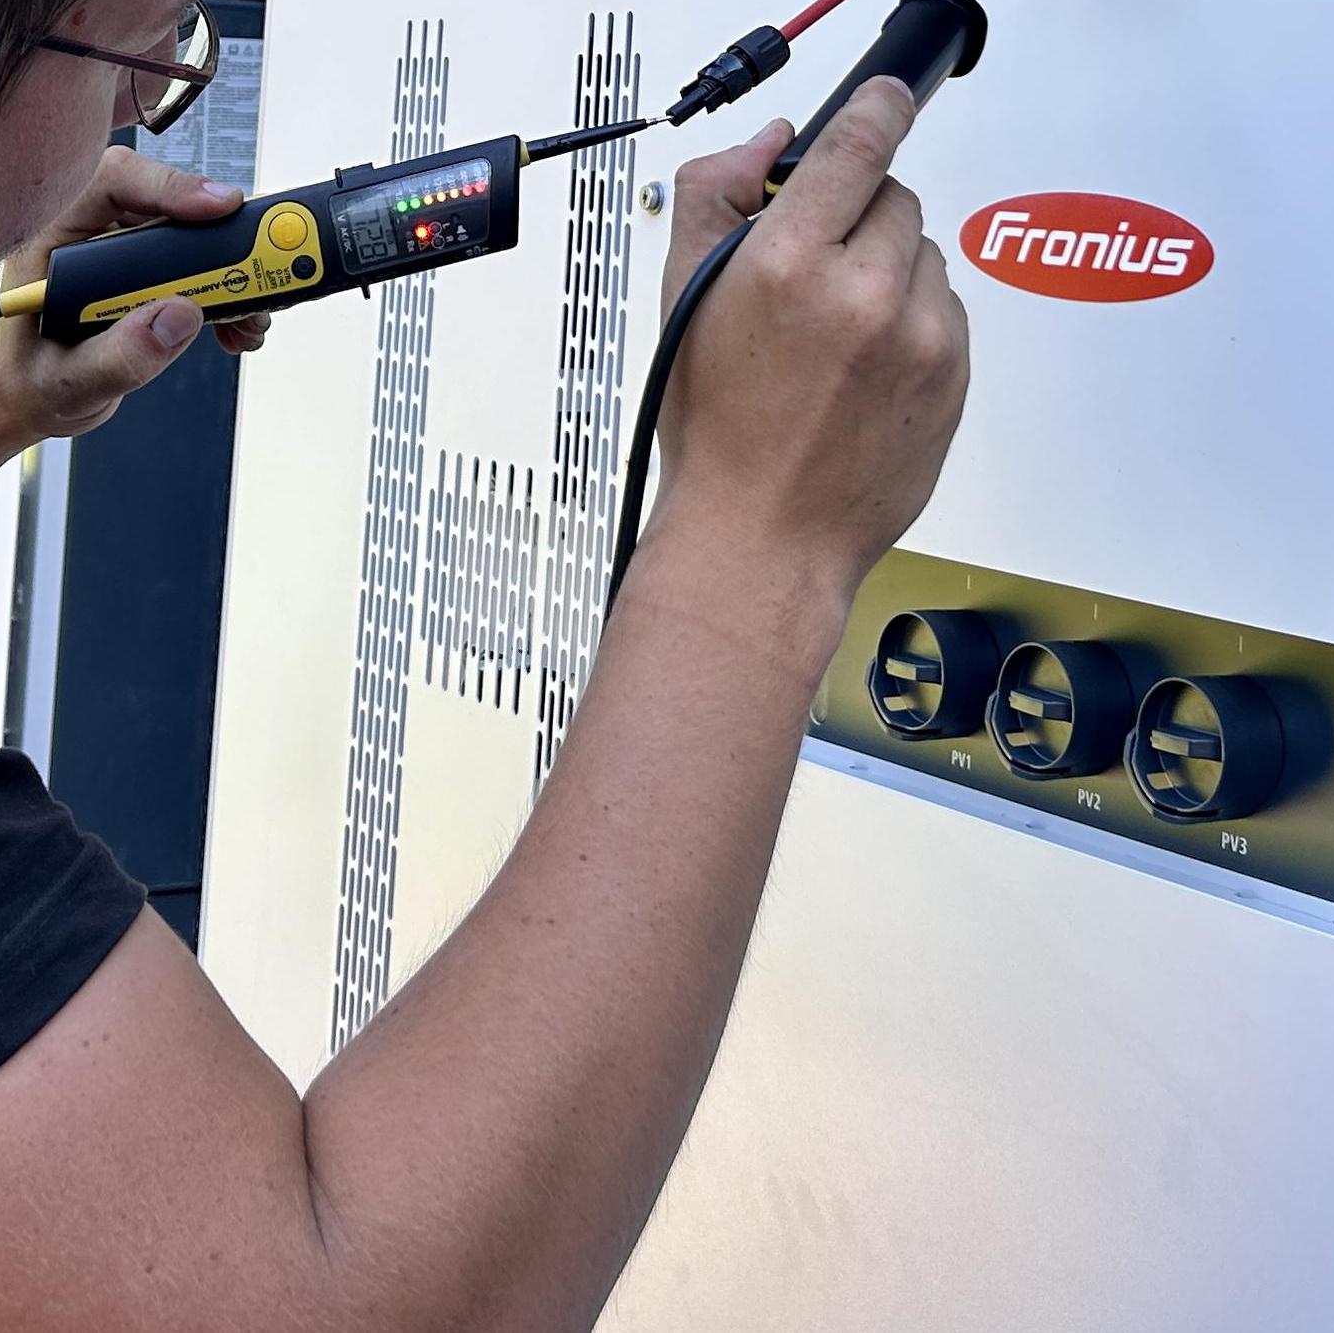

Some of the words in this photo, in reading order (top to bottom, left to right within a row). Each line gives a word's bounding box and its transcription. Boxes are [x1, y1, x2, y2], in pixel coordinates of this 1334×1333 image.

[979, 210, 1195, 276] Fronius
[951, 750, 972, 770] PV1
[1077, 789, 1101, 811] PV2
[1221, 832, 1248, 856] PV3
